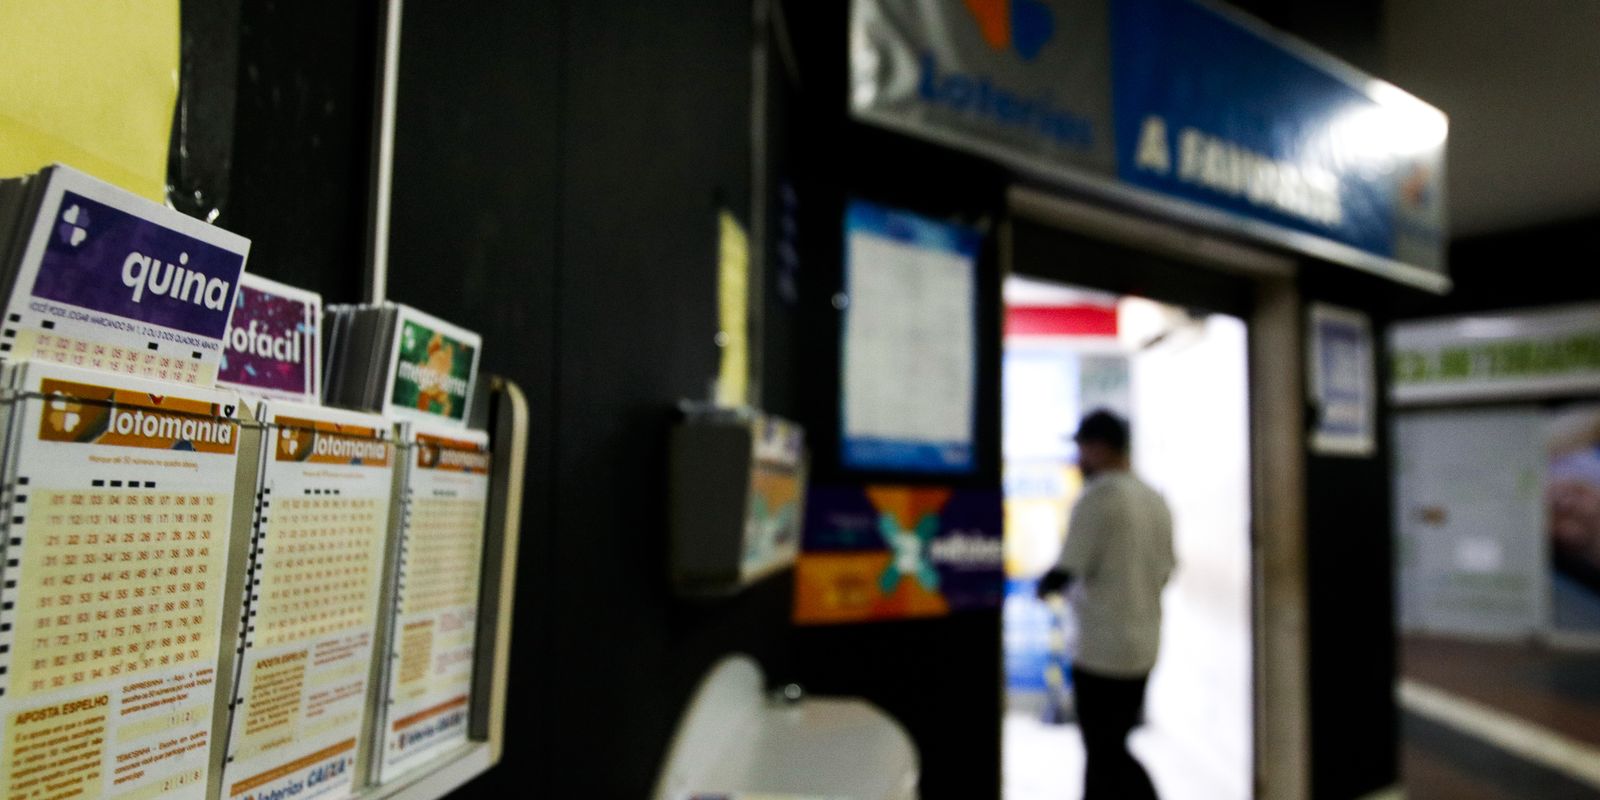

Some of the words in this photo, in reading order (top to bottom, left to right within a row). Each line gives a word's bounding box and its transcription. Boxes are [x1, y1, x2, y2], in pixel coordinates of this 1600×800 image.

[121, 252, 230, 311] quina
[108, 406, 232, 444] lotomania
[313, 434, 387, 460] lotomania
[15, 706, 60, 725] APOSTA
[62, 695, 109, 715] ESPELHO
